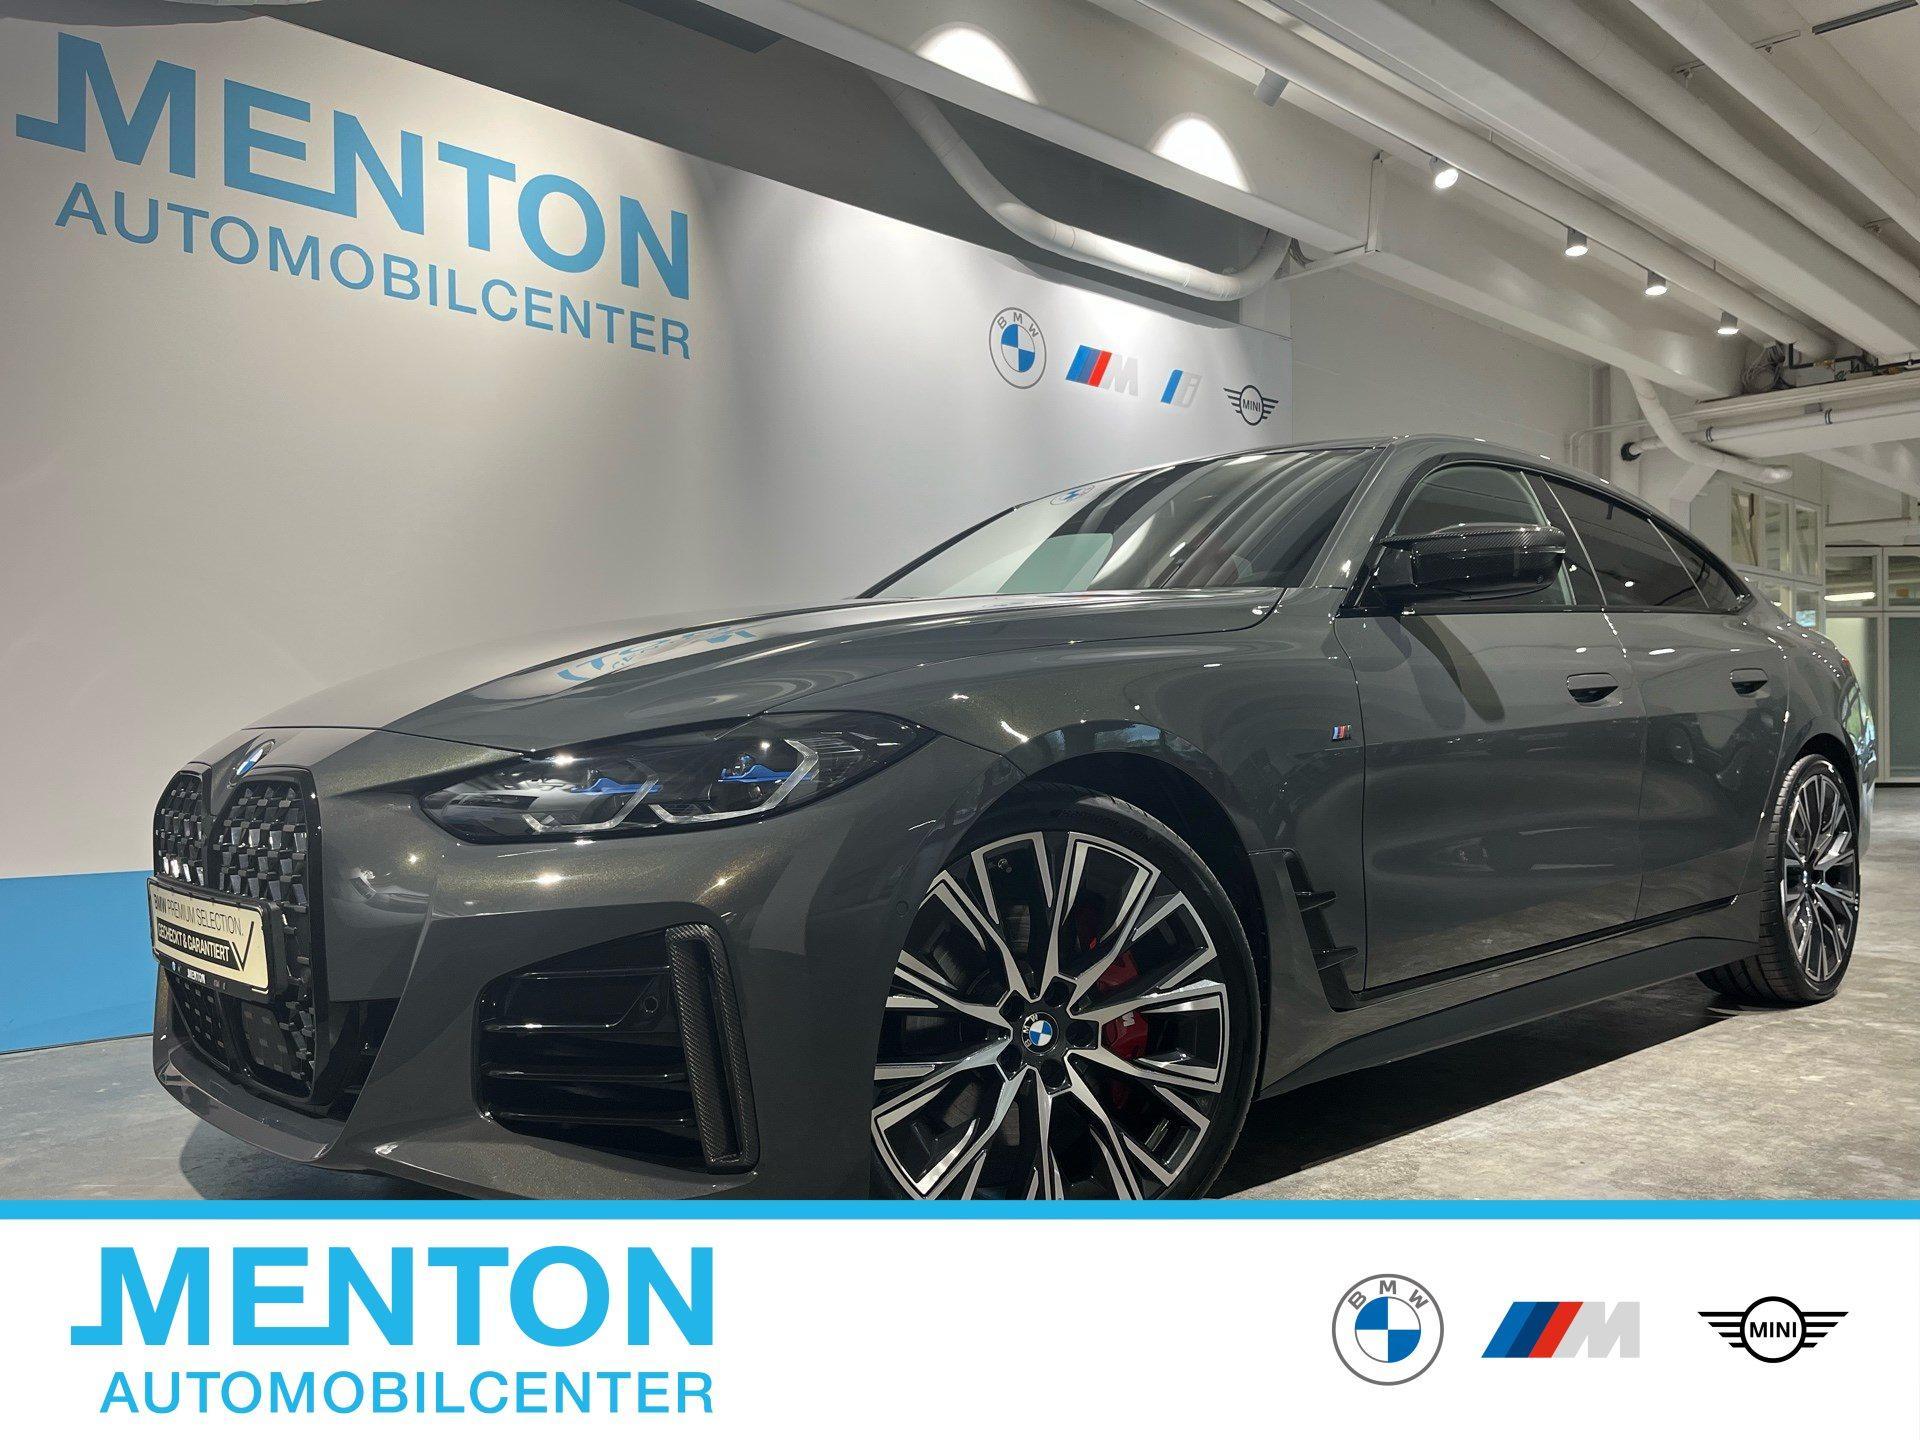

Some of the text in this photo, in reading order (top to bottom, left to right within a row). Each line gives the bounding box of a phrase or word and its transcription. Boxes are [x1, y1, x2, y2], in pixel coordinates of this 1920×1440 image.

[16, 31, 690, 301] MENTON
[54, 181, 691, 360] AUTOMOBILCENTER
[996, 311, 1039, 338] BMW
[1242, 398, 1262, 413] MINI
[166, 899, 195, 924] PREMIUM
[187, 934, 230, 962] GARANTIERT
